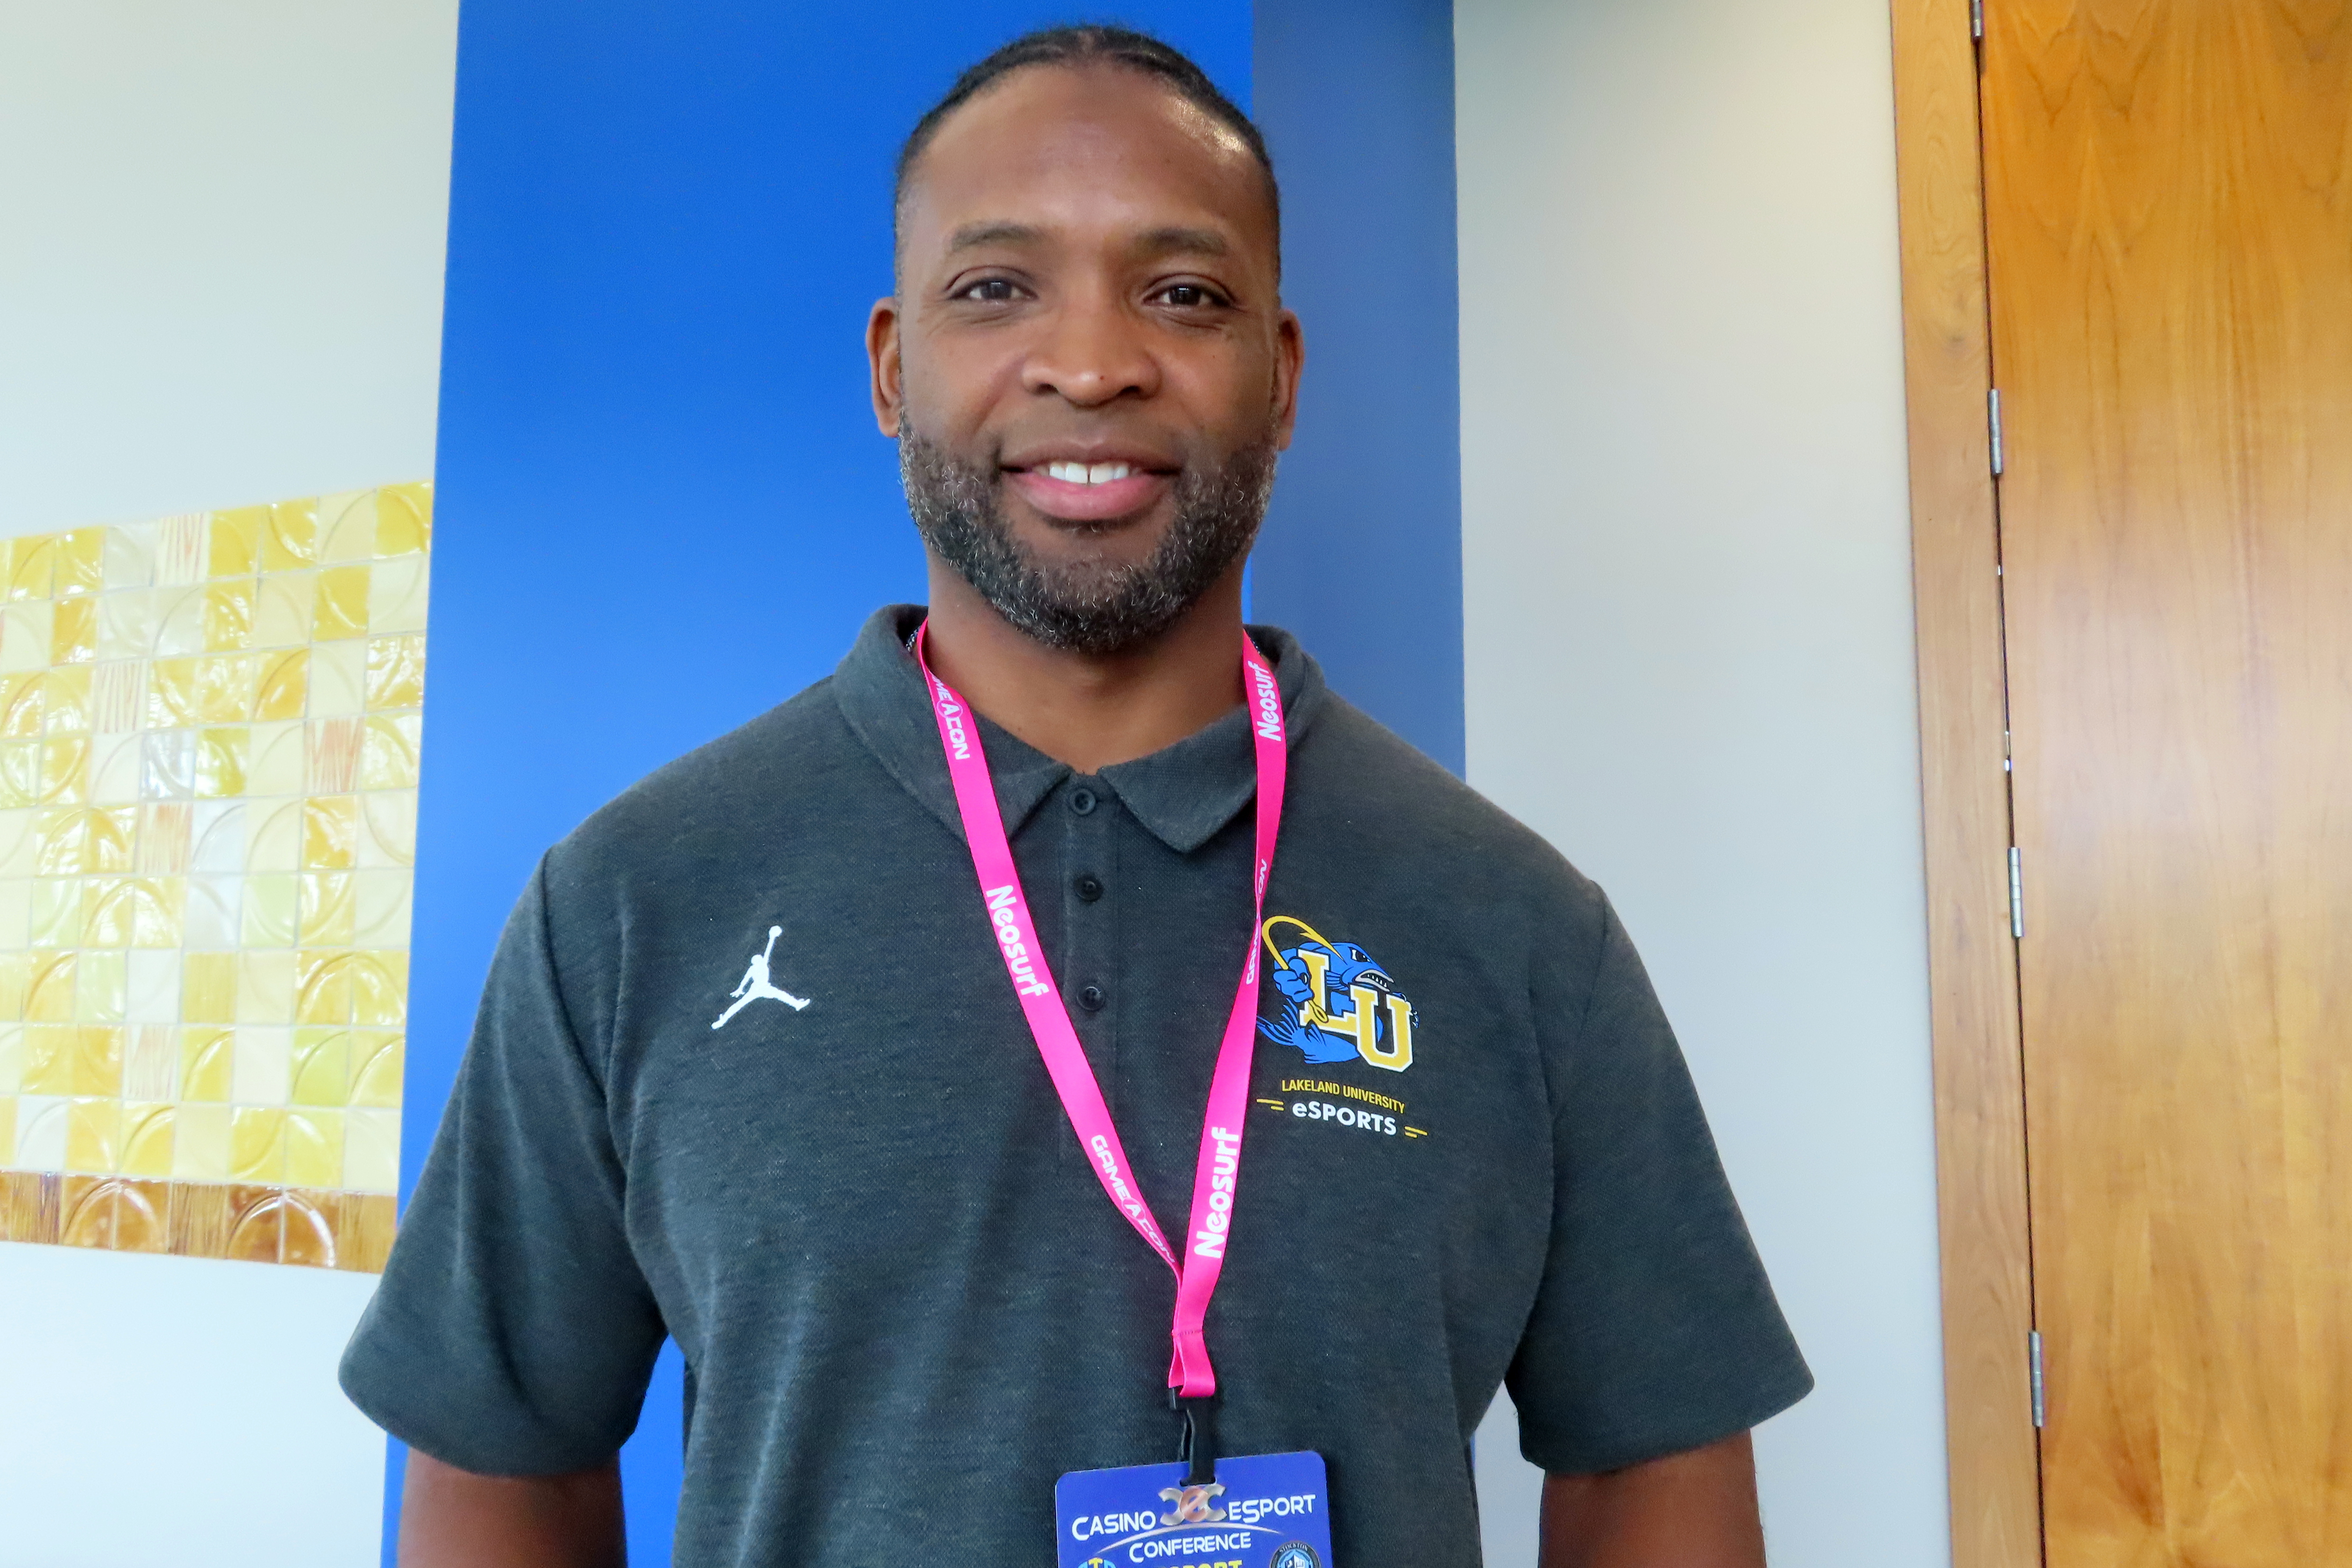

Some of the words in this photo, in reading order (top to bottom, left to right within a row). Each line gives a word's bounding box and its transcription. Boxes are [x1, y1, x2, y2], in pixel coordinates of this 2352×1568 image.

[1248, 660, 1281, 742] Neosurf
[986, 885, 1049, 996] Neosurf
[1297, 949, 1413, 1072] LU
[1281, 1079, 1340, 1095] LAKELAND
[1343, 1085, 1406, 1114] UNIVERSITY
[1292, 1100, 1397, 1135] eSPORTS
[1194, 1126, 1239, 1258] Neosurf
[1072, 1511, 1156, 1541] CASINO
[1228, 1494, 1316, 1523] ESPORT
[1129, 1532, 1251, 1563] CONFERENCE
